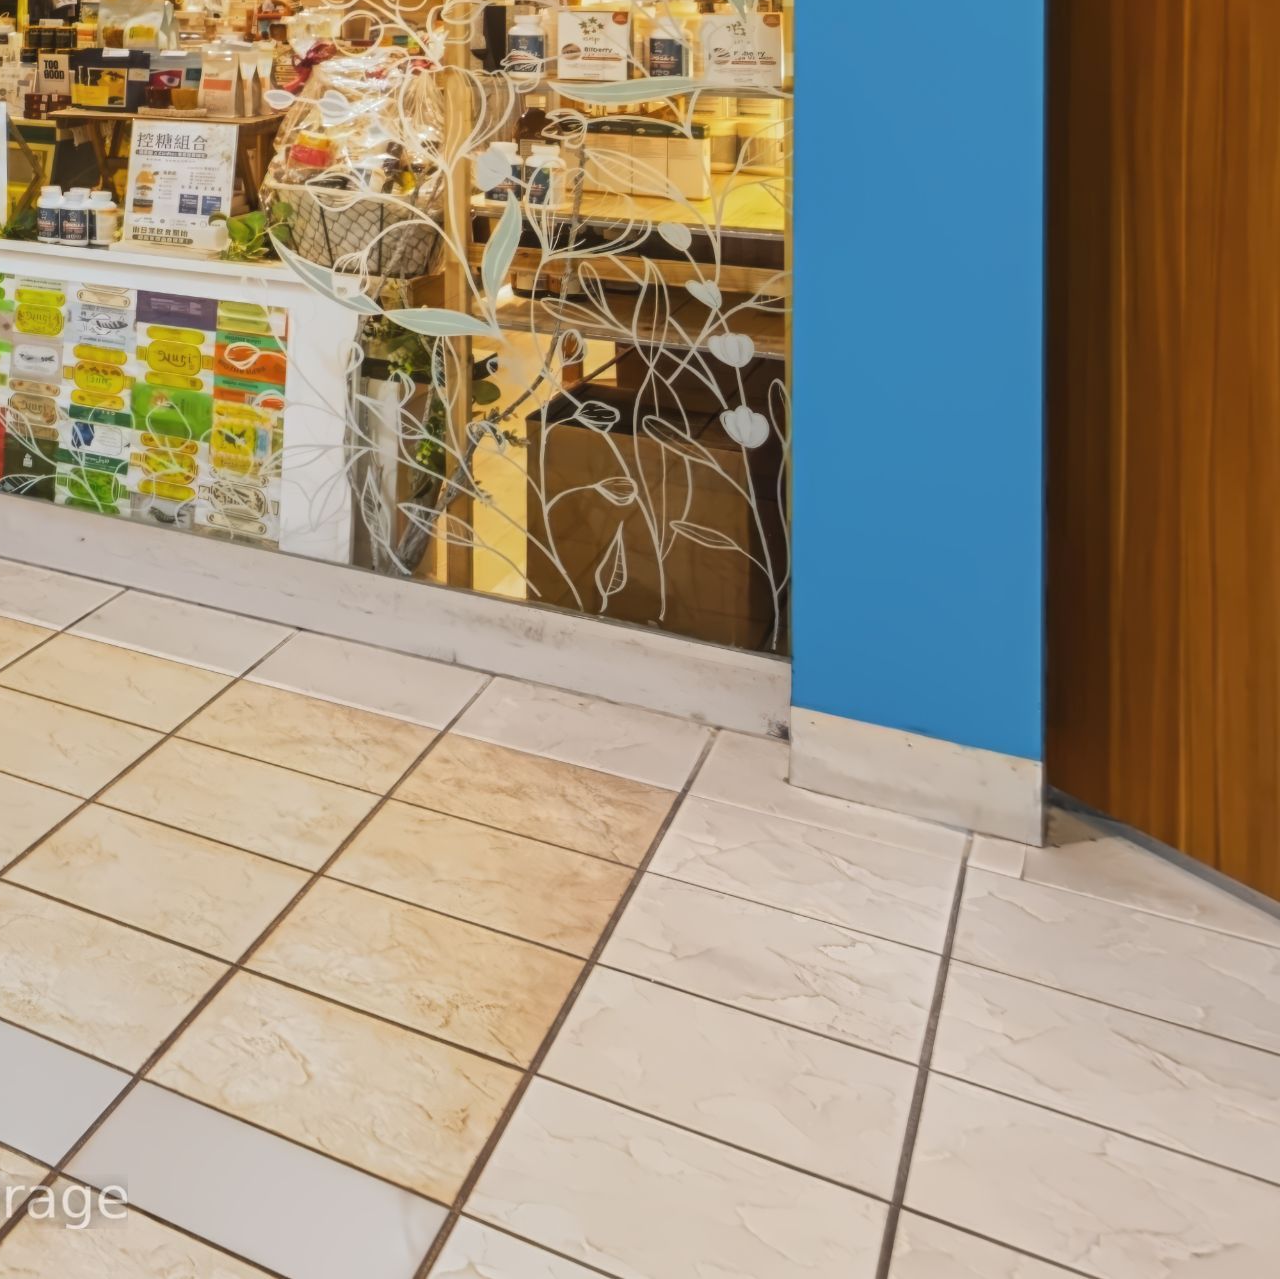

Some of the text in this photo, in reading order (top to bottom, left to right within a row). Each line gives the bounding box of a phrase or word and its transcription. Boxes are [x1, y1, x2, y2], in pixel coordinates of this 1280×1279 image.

[43, 71, 65, 80] GOOD
[137, 131, 208, 151] 控糖組合
